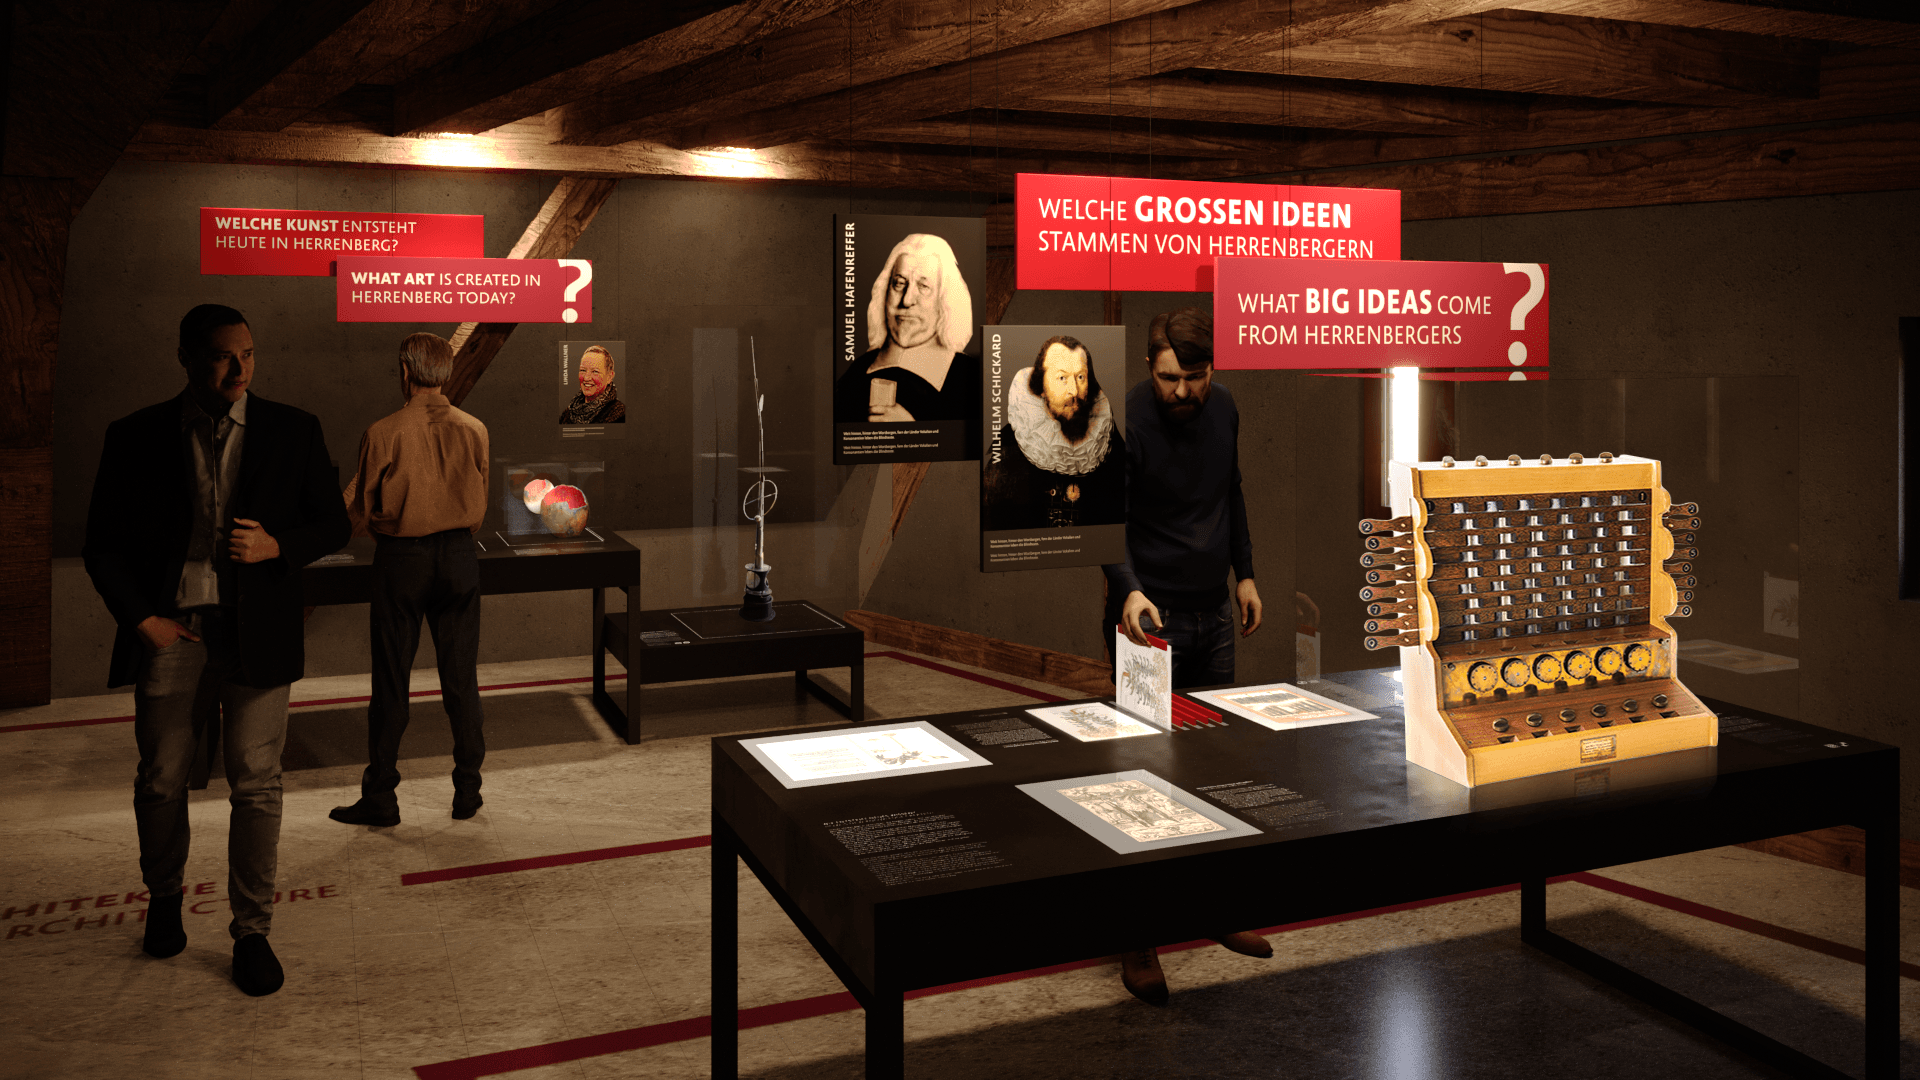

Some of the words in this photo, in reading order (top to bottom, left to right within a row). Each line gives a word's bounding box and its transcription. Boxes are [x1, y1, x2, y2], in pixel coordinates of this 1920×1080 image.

[215, 215, 282, 231] WELCHE
[286, 218, 340, 232] KUNST
[342, 219, 418, 234] ENTSTEHT
[1038, 196, 1128, 223] WELCHE
[1134, 194, 1265, 226] GROSSEN
[1272, 200, 1352, 229] IDEEN
[215, 235, 267, 249] HEUTE
[271, 236, 288, 249] IN
[293, 237, 399, 252] HERRENBERG?
[1037, 229, 1149, 255] STAMMEN
[1153, 233, 1201, 256] VON
[1208, 235, 1375, 260] HERRENBERGERN
[350, 271, 402, 286] WHAT
[403, 272, 436, 287] ART
[438, 272, 452, 287] IS
[454, 273, 521, 288] CREATED
[524, 274, 541, 288] IN
[844, 222, 856, 308] HAFENREFFER
[351, 290, 453, 305] HERRENBERG
[456, 291, 516, 306] TODAY?
[557, 259, 593, 325] ?
[1237, 292, 1300, 315] WHAT
[1304, 287, 1350, 315] BIG
[1357, 288, 1434, 316] IDEAS
[1437, 295, 1492, 316] COME
[1502, 263, 1546, 367] ?
[844, 310, 856, 361] SAMUEL
[1237, 324, 1298, 346] FROM
[1304, 324, 1463, 346] HERRENBERGERS
[990, 333, 1003, 404] SCHICKARD
[990, 405, 1003, 465] WILHELM
